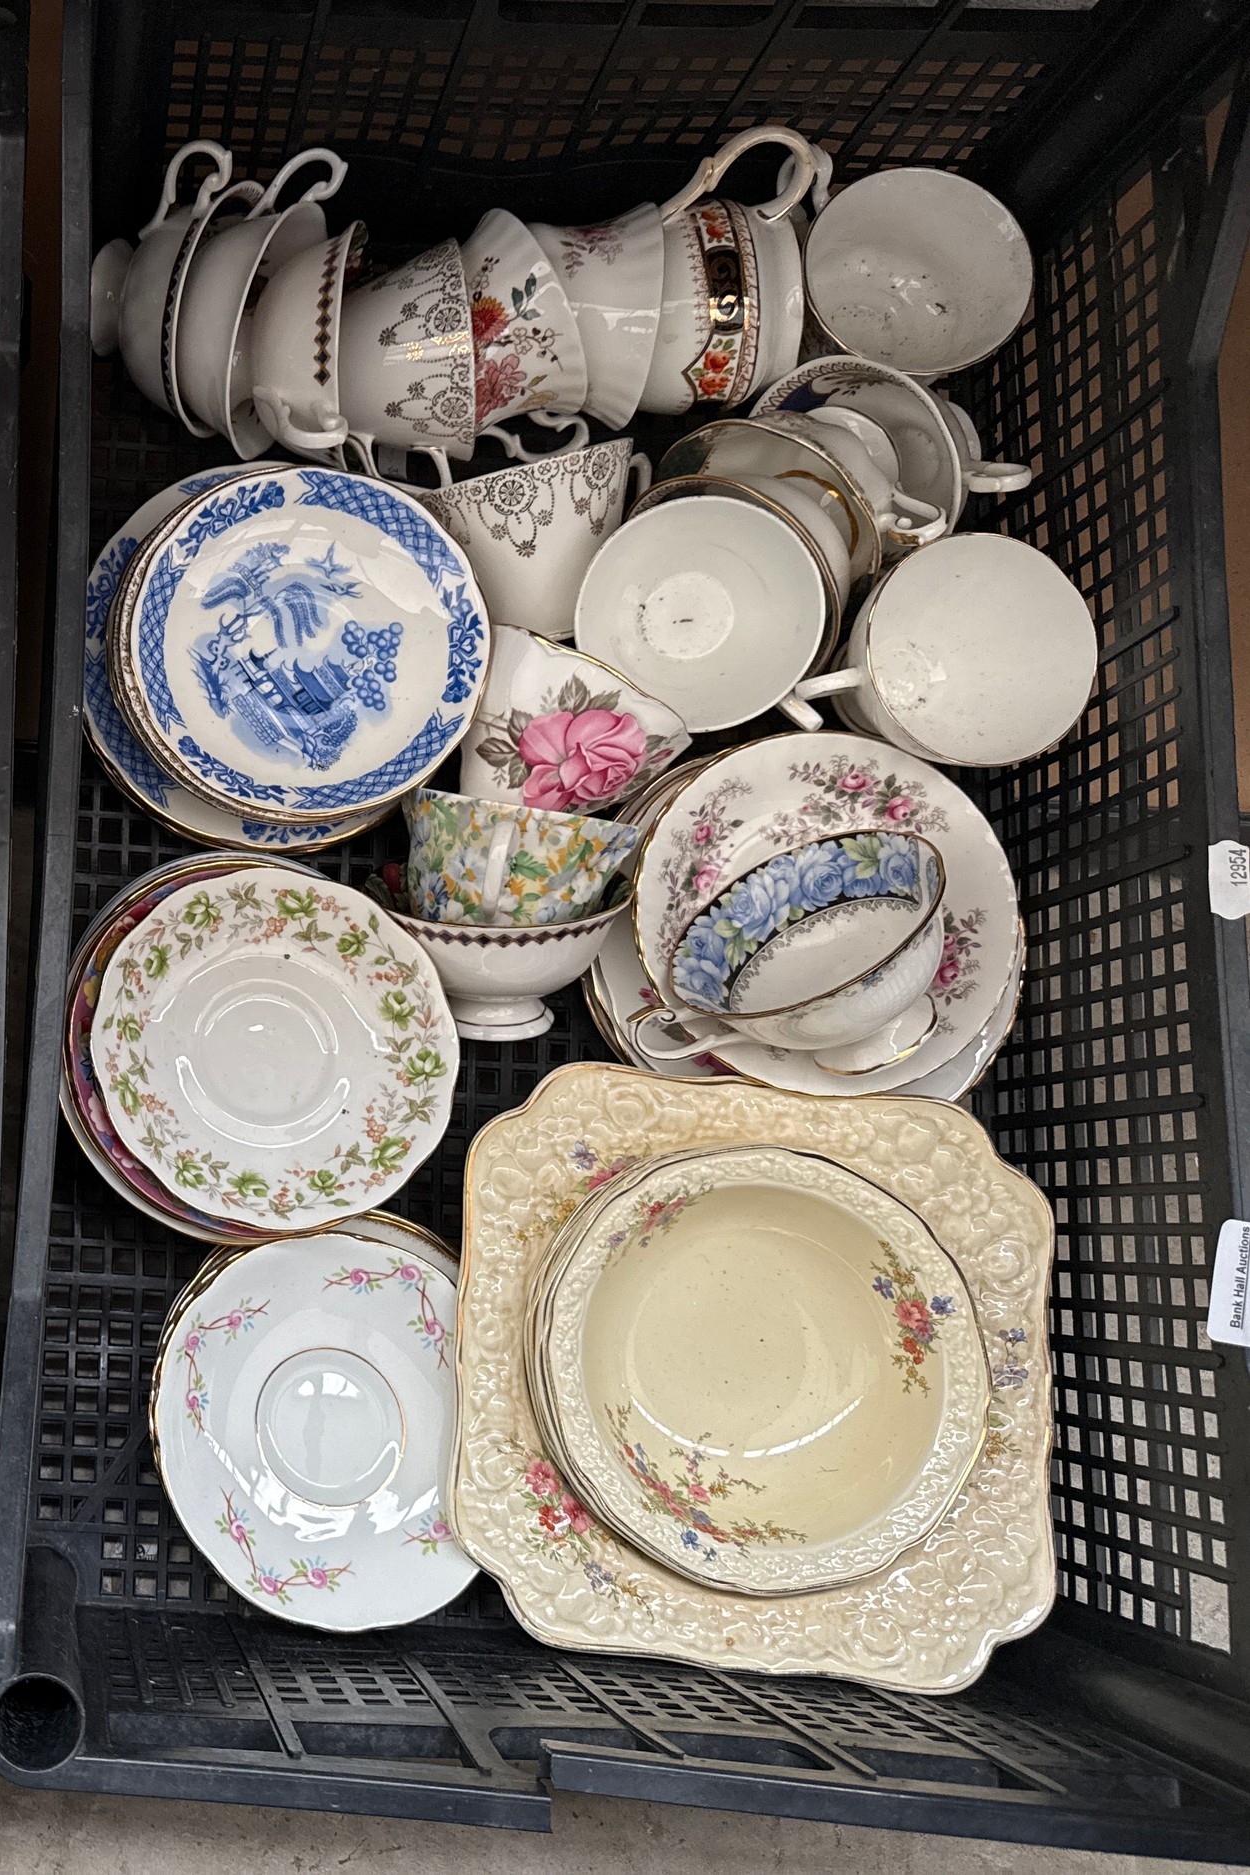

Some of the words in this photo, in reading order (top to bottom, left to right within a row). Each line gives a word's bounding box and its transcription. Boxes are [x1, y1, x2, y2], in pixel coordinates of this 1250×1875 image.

[1228, 848, 1248, 887] 12954
[1236, 1226, 1250, 1275] Auctions
[1233, 1276, 1246, 1298] Hall
[1229, 1300, 1243, 1329] Bank
